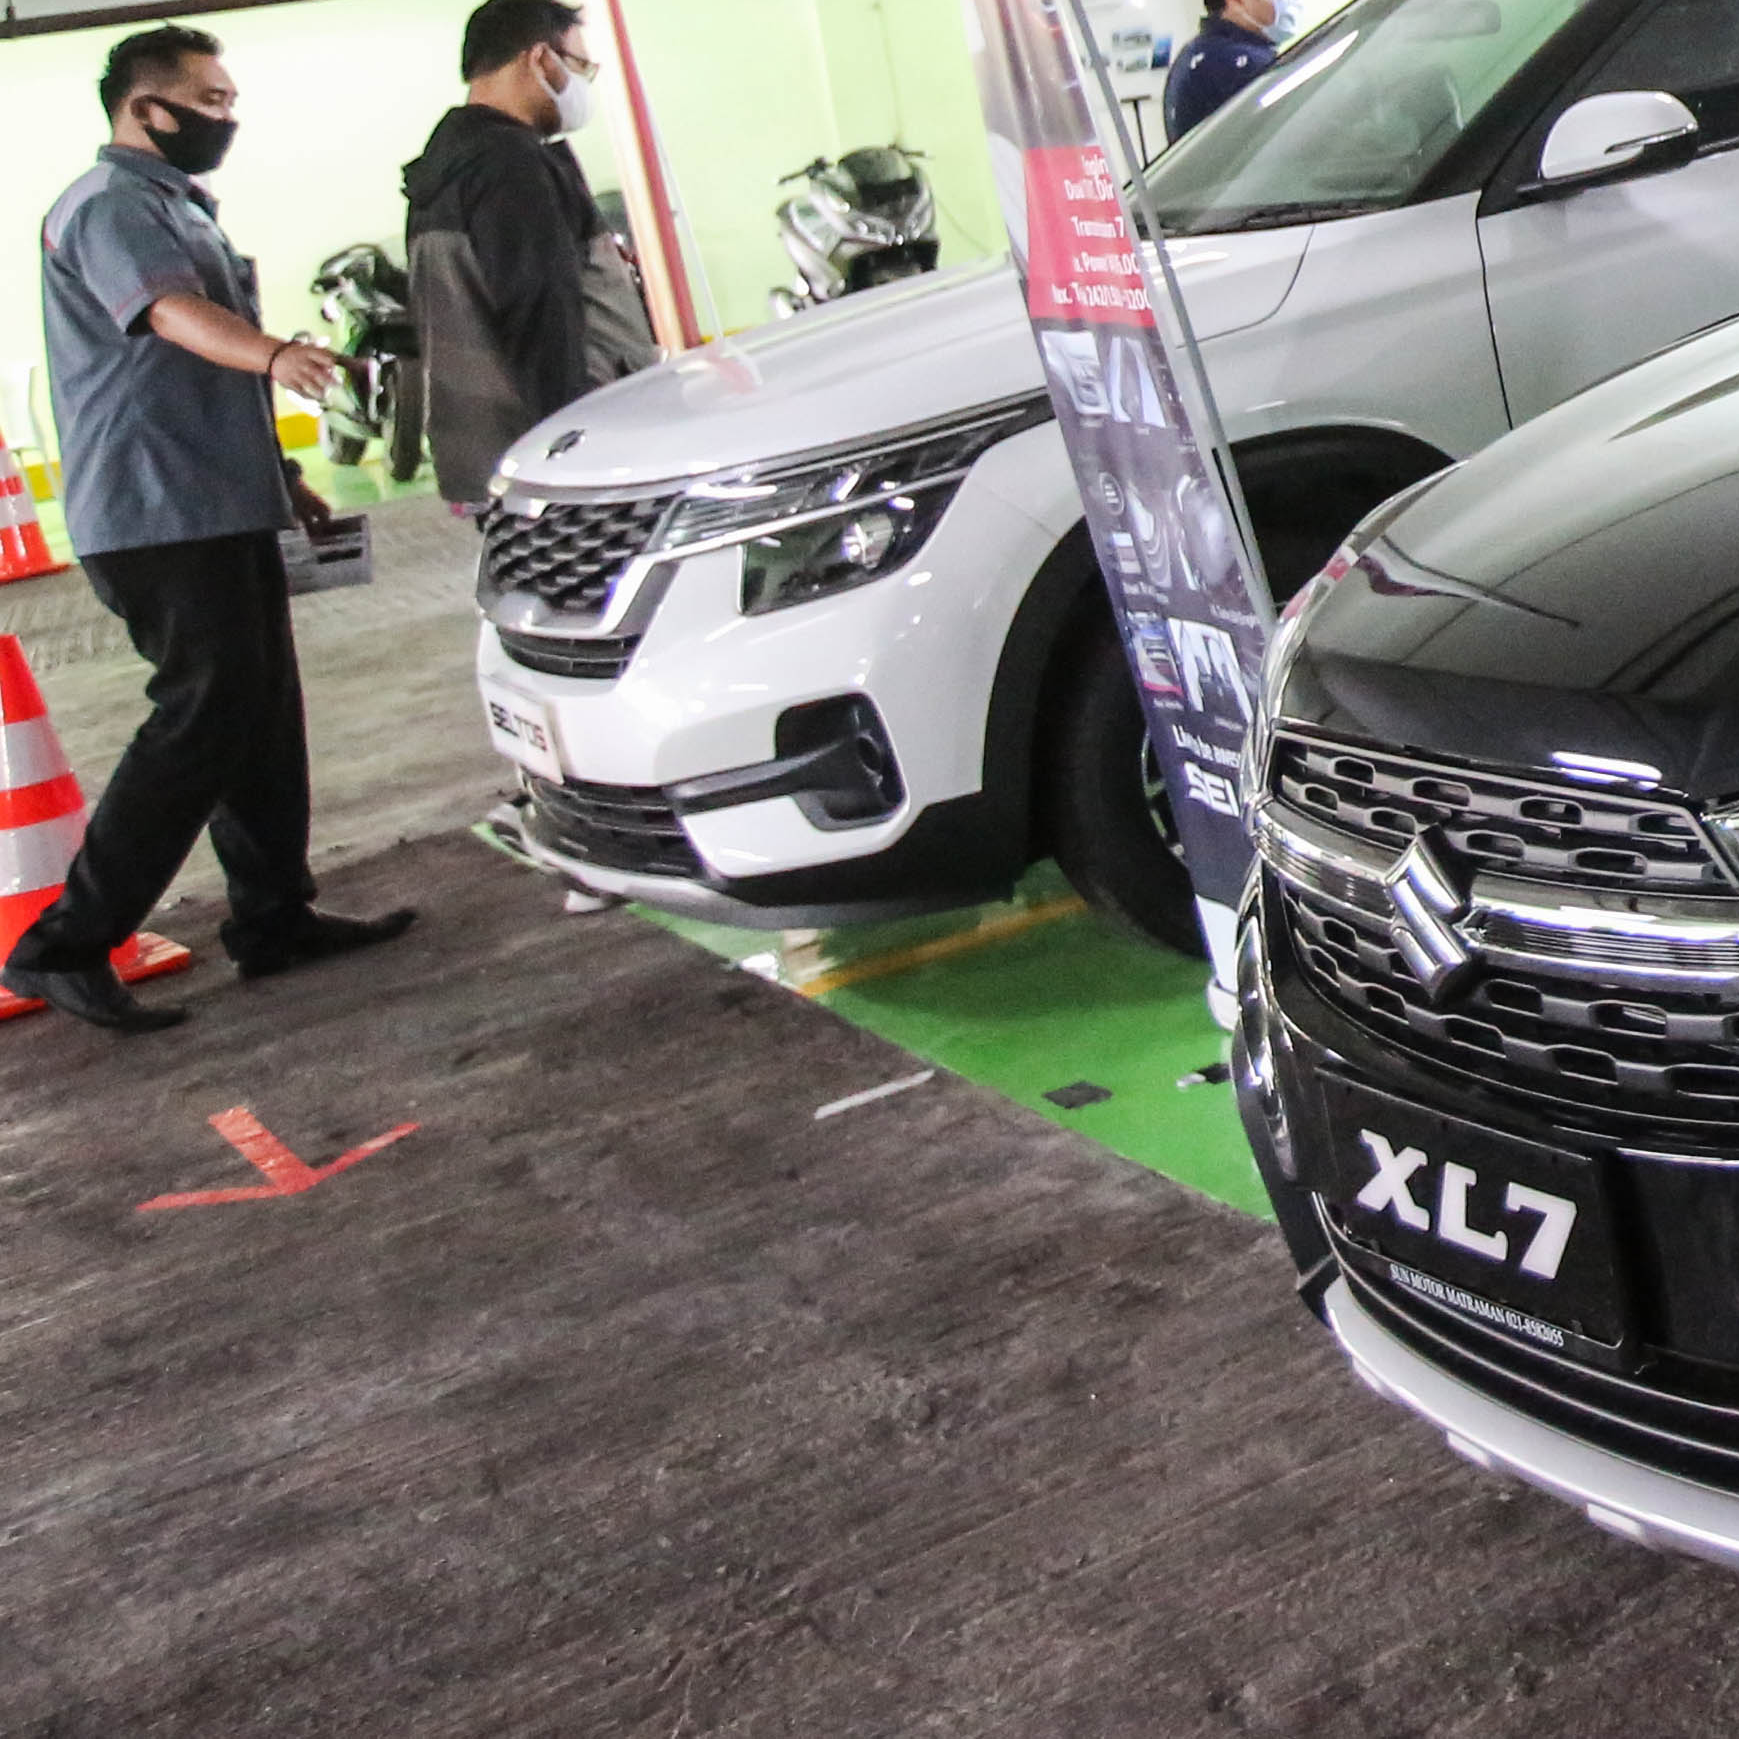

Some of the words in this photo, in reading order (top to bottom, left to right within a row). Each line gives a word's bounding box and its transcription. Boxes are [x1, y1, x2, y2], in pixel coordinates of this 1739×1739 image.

[490, 701, 547, 752] SELTOS
[1356, 1128, 1577, 1280] XL7
[1389, 1263, 1410, 1285] SUN
[1410, 1272, 1446, 1299] MOTOR
[1446, 1287, 1506, 1324] MATRAMAN
